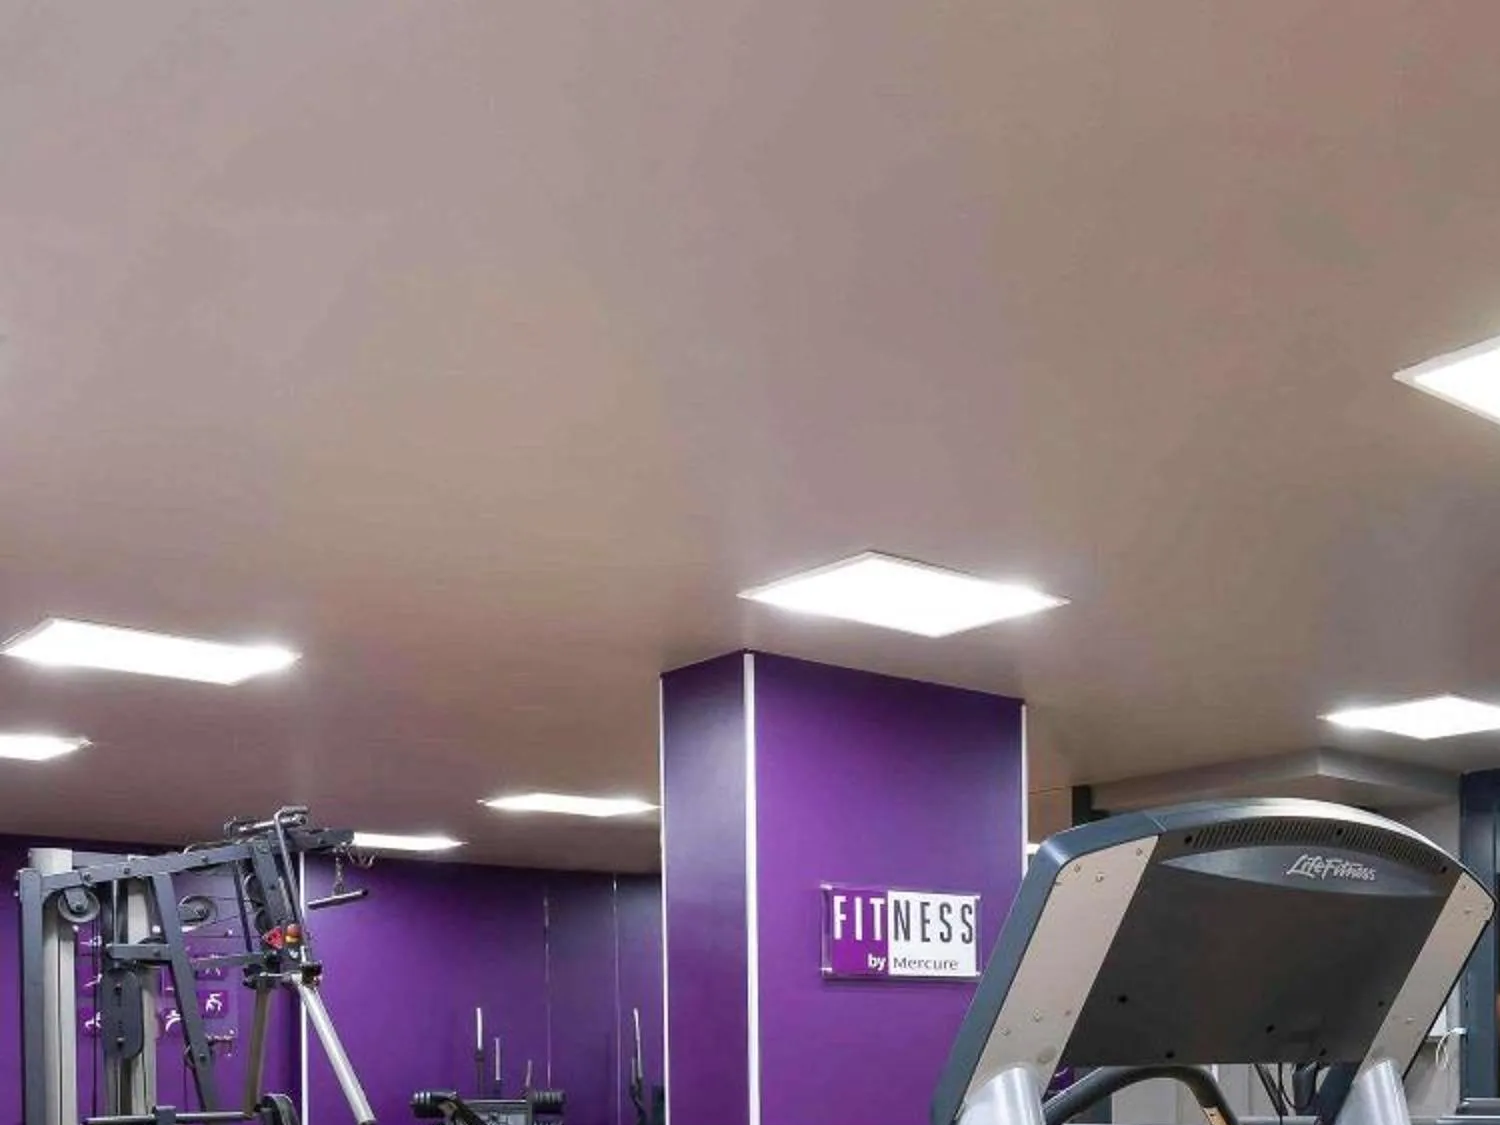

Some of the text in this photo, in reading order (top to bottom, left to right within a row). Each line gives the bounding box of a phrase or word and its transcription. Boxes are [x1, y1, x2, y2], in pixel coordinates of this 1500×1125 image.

[833, 895, 974, 945] FITNESS
[868, 953, 959, 971] by Mercure
